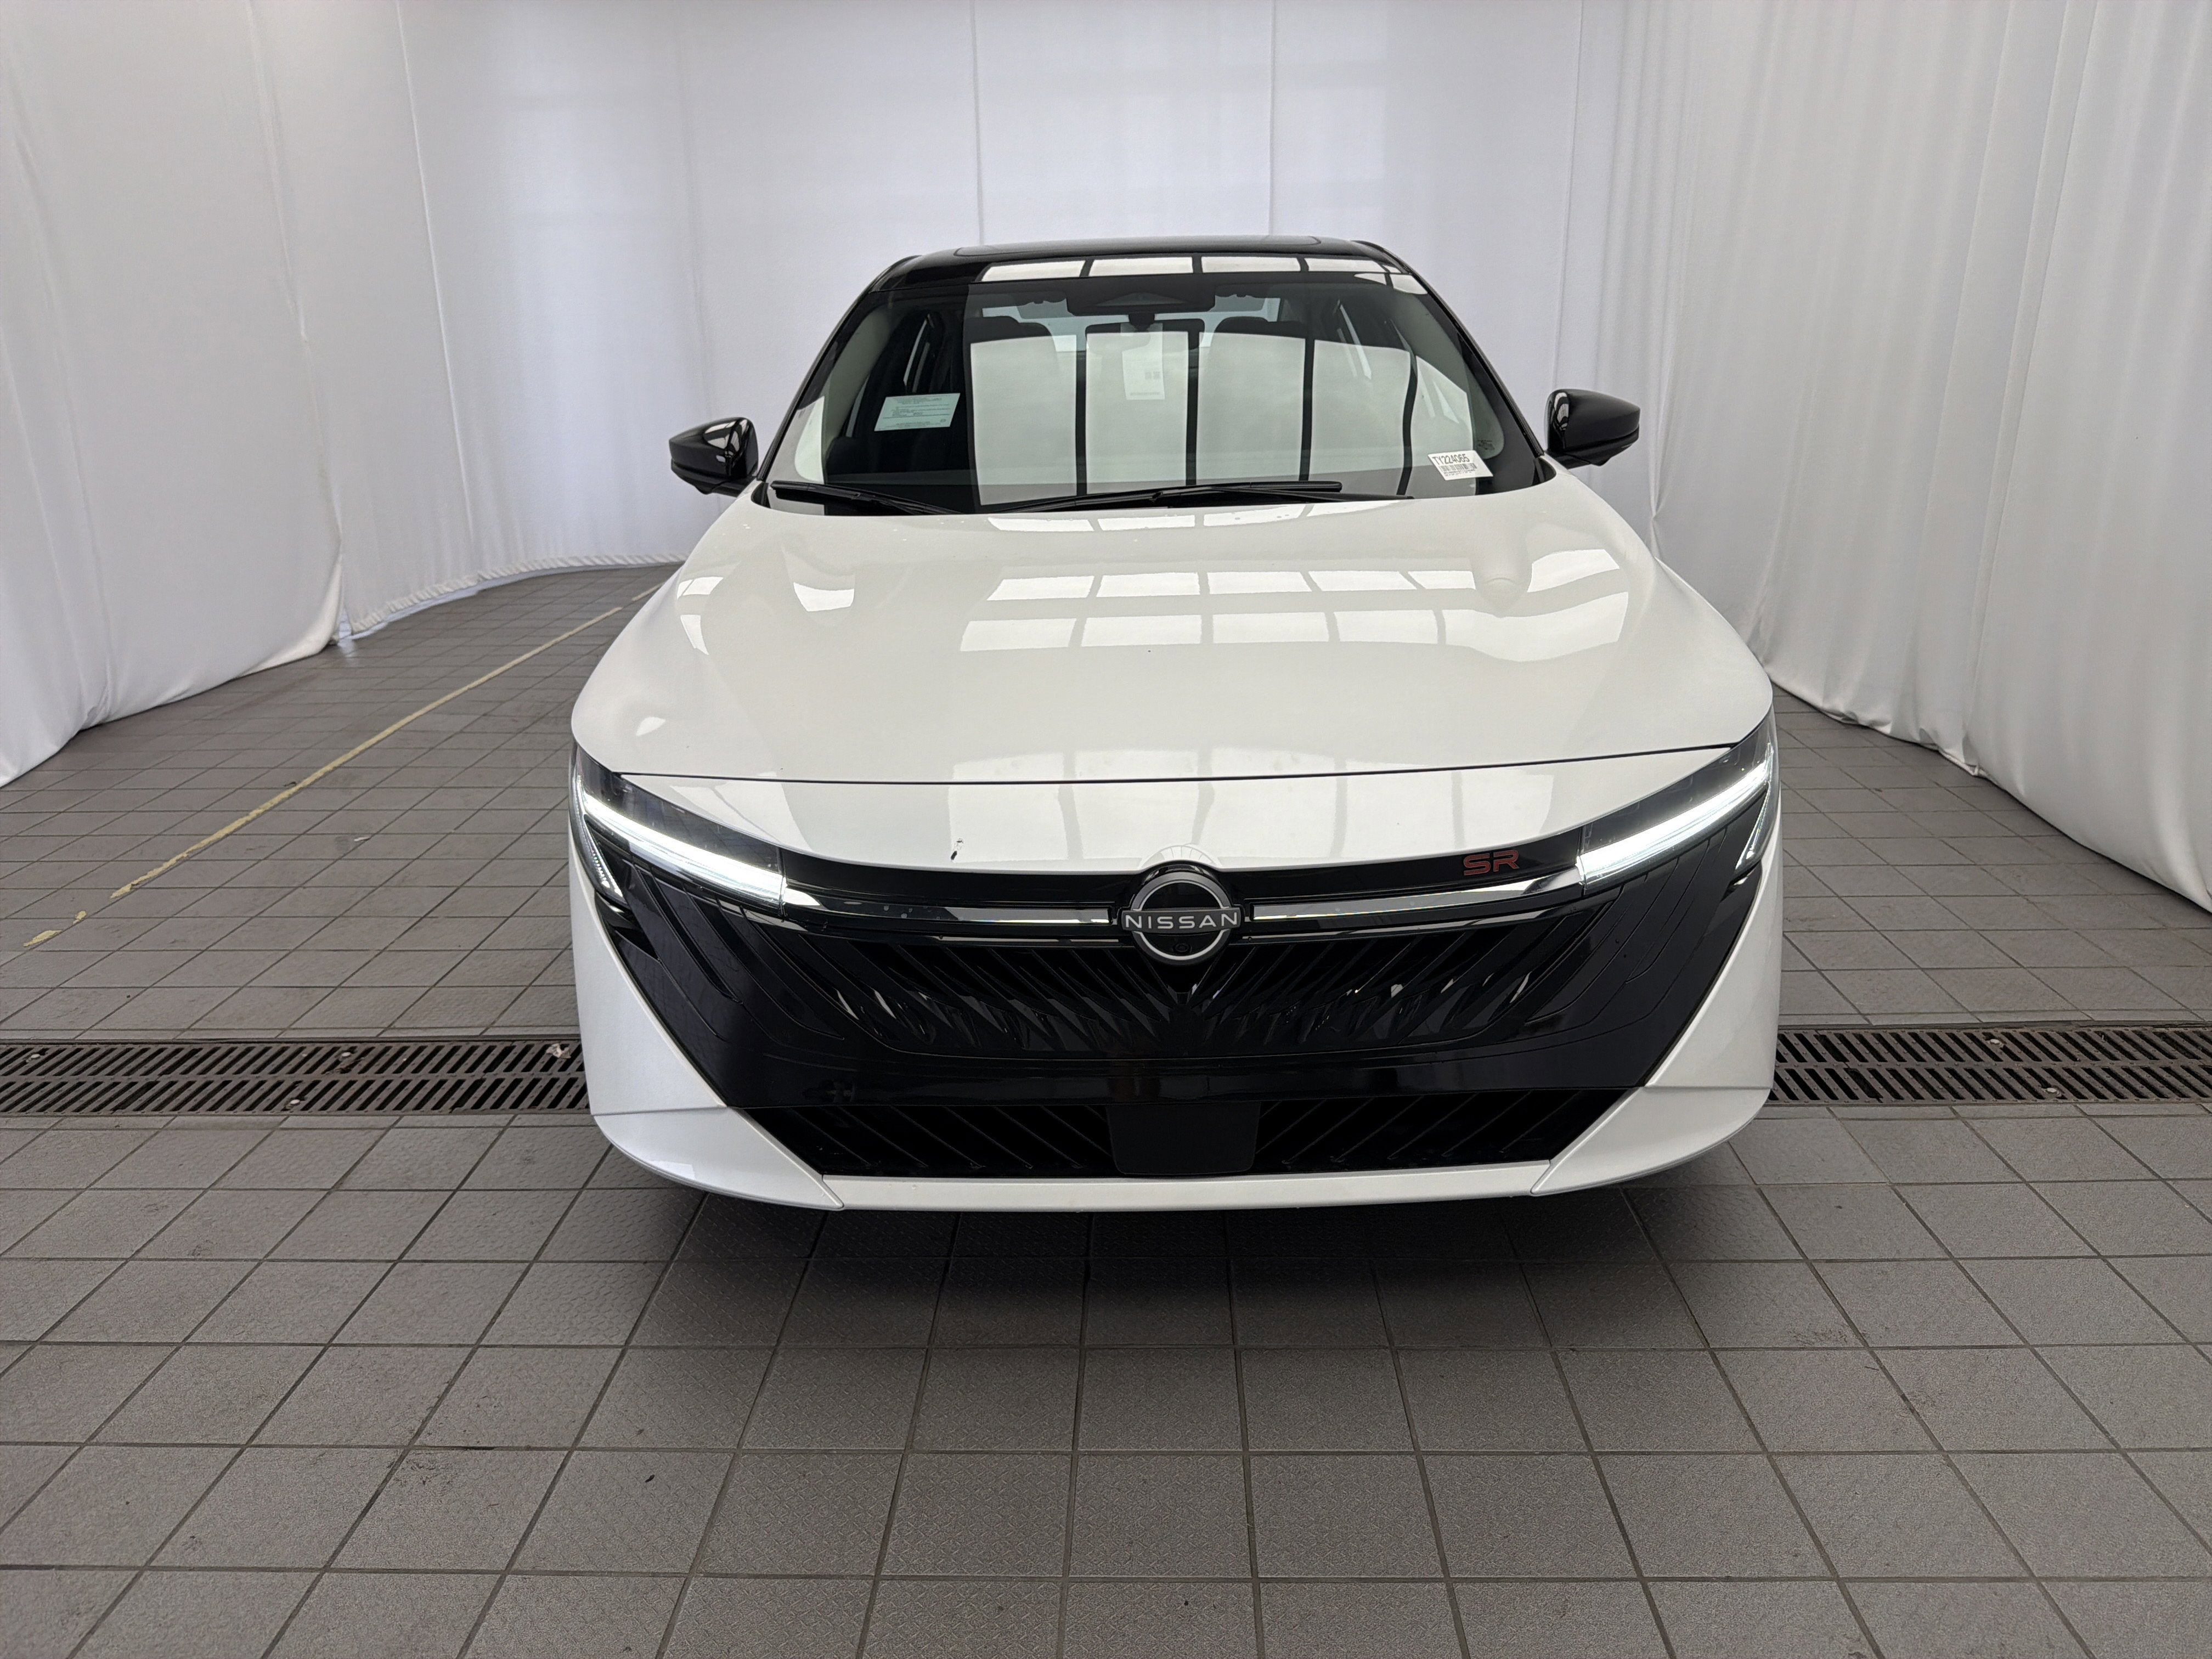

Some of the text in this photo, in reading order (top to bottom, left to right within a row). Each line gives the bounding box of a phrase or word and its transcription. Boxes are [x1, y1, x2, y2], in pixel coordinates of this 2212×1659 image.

[1432, 453, 1470, 465] TY224065
[1463, 849, 1519, 876] SR
[1125, 912, 1237, 929] NISSAN
